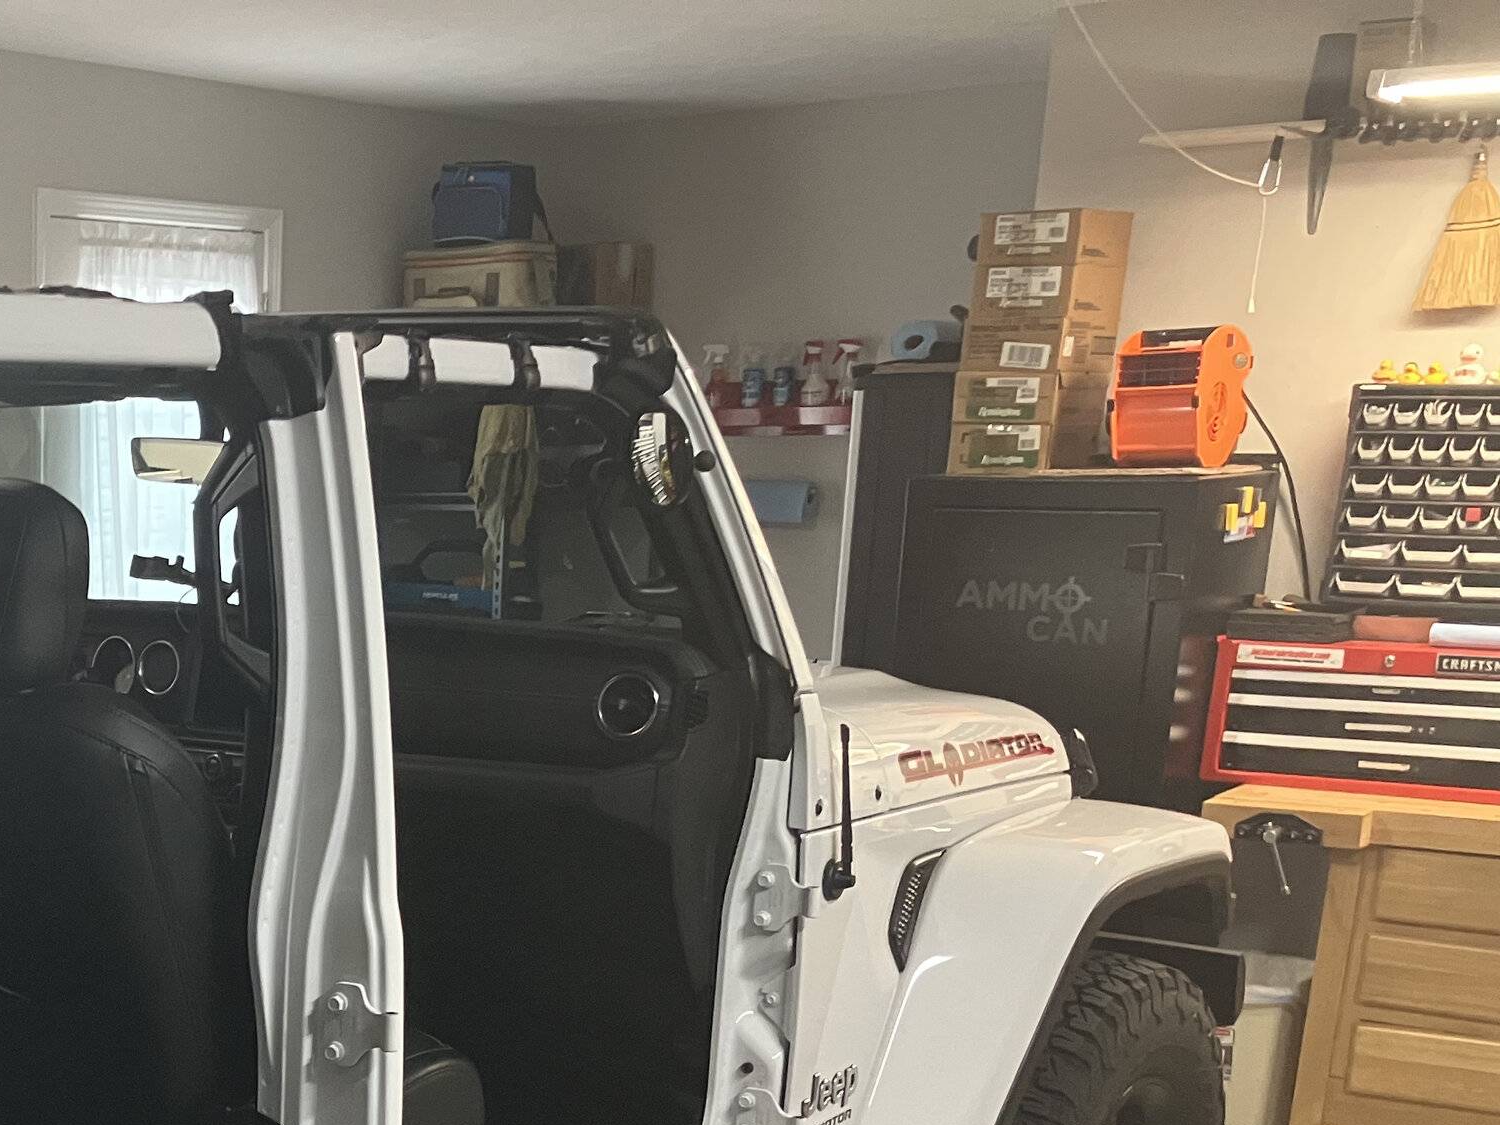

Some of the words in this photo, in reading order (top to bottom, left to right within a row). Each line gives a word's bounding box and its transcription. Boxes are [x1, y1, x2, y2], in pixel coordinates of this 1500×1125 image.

[955, 575, 1093, 614] AMMO
[1026, 615, 1109, 646] CAN
[801, 1064, 859, 1119] Jeep
